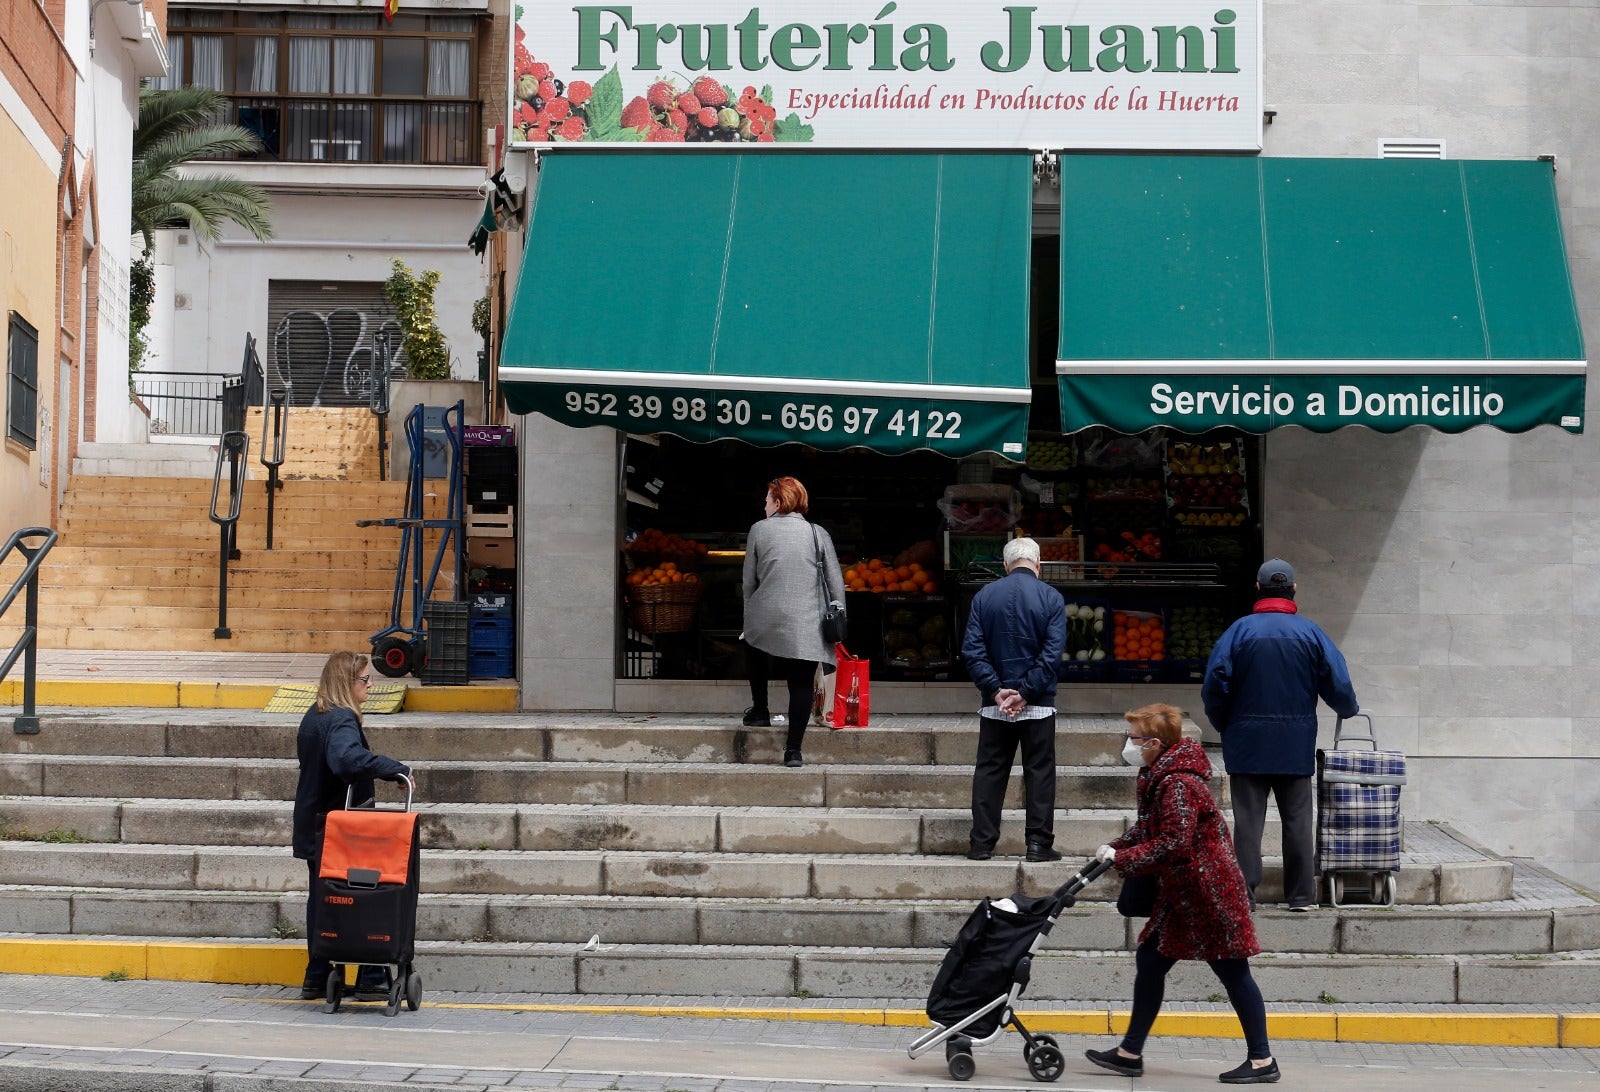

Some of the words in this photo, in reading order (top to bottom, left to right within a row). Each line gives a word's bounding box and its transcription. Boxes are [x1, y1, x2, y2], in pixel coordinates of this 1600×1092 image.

[571, 1, 956, 73] Frutería
[979, 7, 1241, 74] Juani
[786, 83, 938, 119] Especialidad
[938, 94, 966, 111] en
[974, 84, 1087, 111] Productos
[1093, 85, 1120, 111] de
[1126, 85, 1149, 111] la
[1157, 89, 1240, 112] Huerta
[564, 391, 619, 416] 952
[627, 395, 663, 419] 39
[671, 397, 707, 422] 98
[716, 399, 752, 426] 30
[780, 402, 834, 432] 656
[843, 406, 880, 435] 97
[887, 409, 963, 439] 4122
[1149, 382, 1296, 415] Servicio
[1305, 393, 1327, 416] a
[1337, 384, 1505, 417] Domicilio
